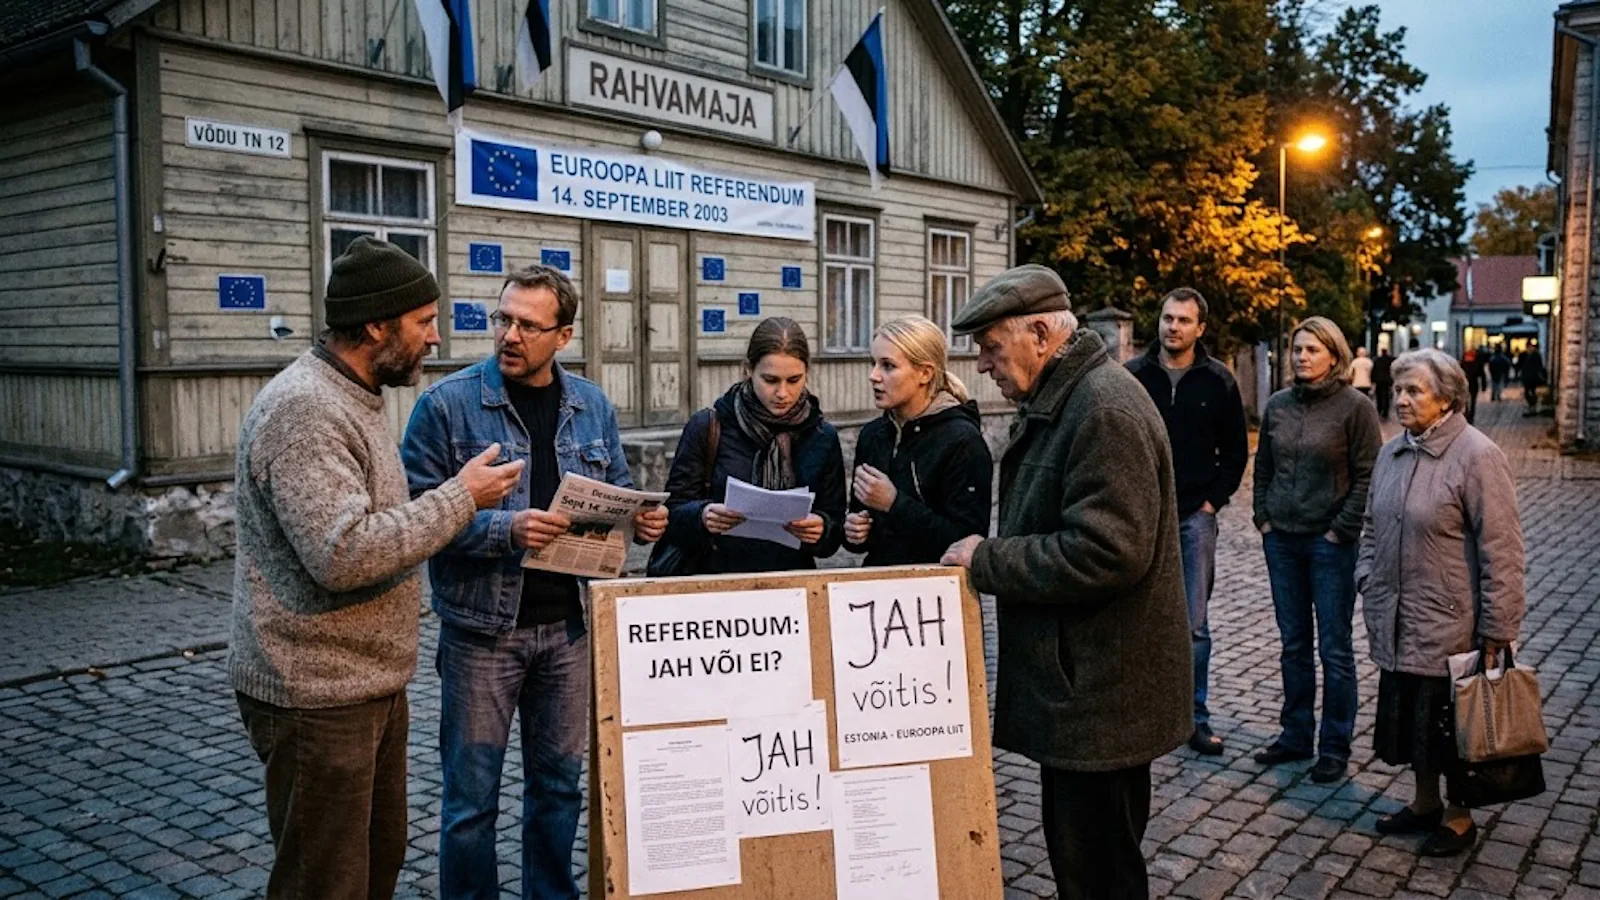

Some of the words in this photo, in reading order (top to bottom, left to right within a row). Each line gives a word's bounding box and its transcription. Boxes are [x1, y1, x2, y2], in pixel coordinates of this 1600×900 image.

[590, 61, 757, 129] RAHVAMAJA
[243, 132, 262, 148] TN
[268, 135, 285, 151] 12
[550, 153, 648, 186] EUROOPA
[654, 169, 685, 191] LIIT
[691, 175, 805, 207] REFERENDUM
[551, 186, 578, 206] 14.
[584, 189, 690, 219] SEPTEMBER
[694, 203, 729, 223] 2003
[629, 616, 800, 644] REFERENDUM:
[848, 595, 946, 669] JAH
[649, 657, 693, 679] JAH
[700, 649, 742, 676] VÕI
[751, 650, 783, 673] EI?
[844, 731, 889, 744] ESTONIA
[896, 726, 945, 740] EUROOPA
[947, 724, 965, 735] LIIT
[741, 729, 814, 783] JAH
